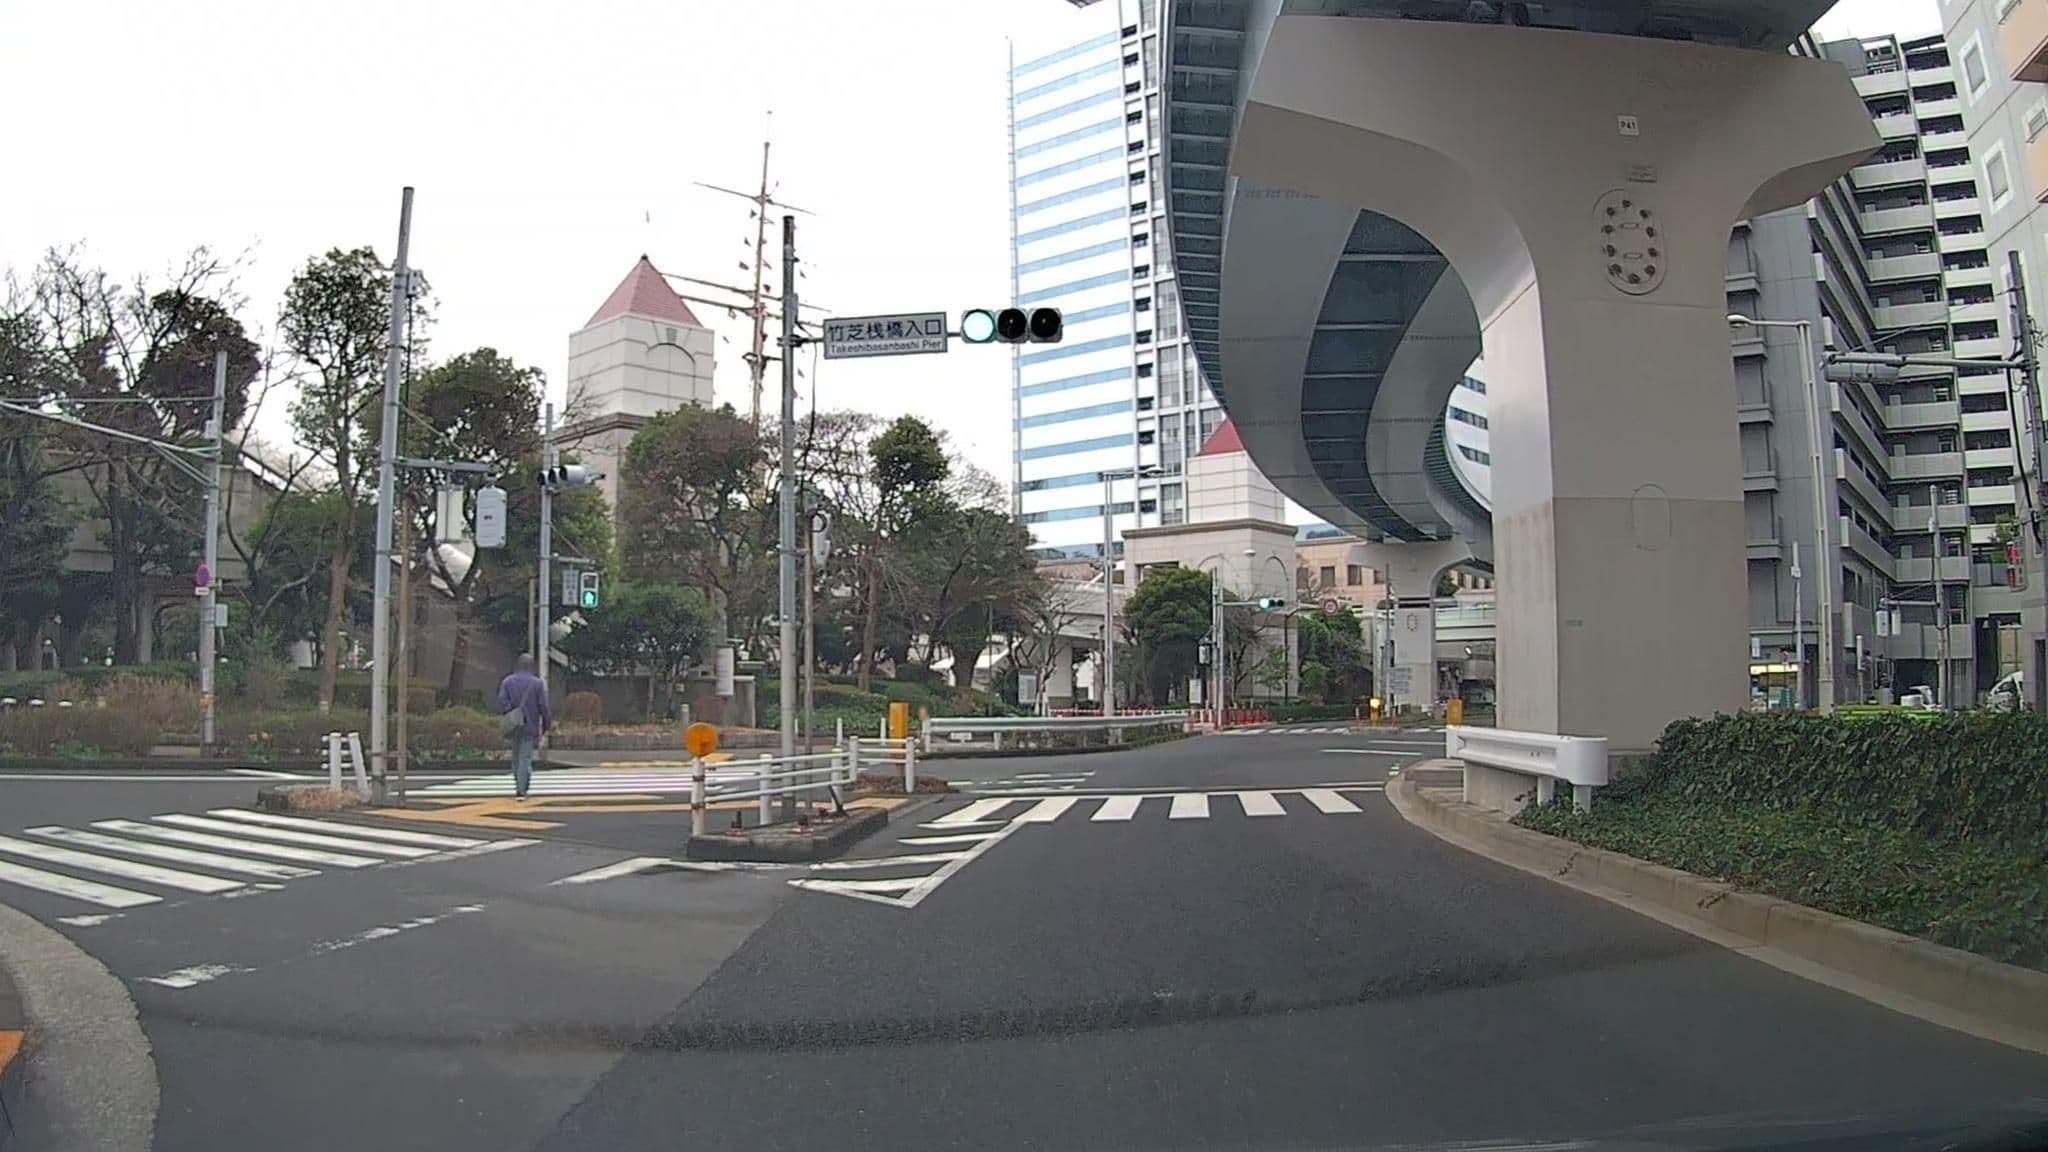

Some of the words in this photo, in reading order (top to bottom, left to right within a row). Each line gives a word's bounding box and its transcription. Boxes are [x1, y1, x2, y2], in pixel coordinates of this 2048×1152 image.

[828, 319, 942, 341] 竹芝桟橋入口
[922, 339, 942, 349] Pier
